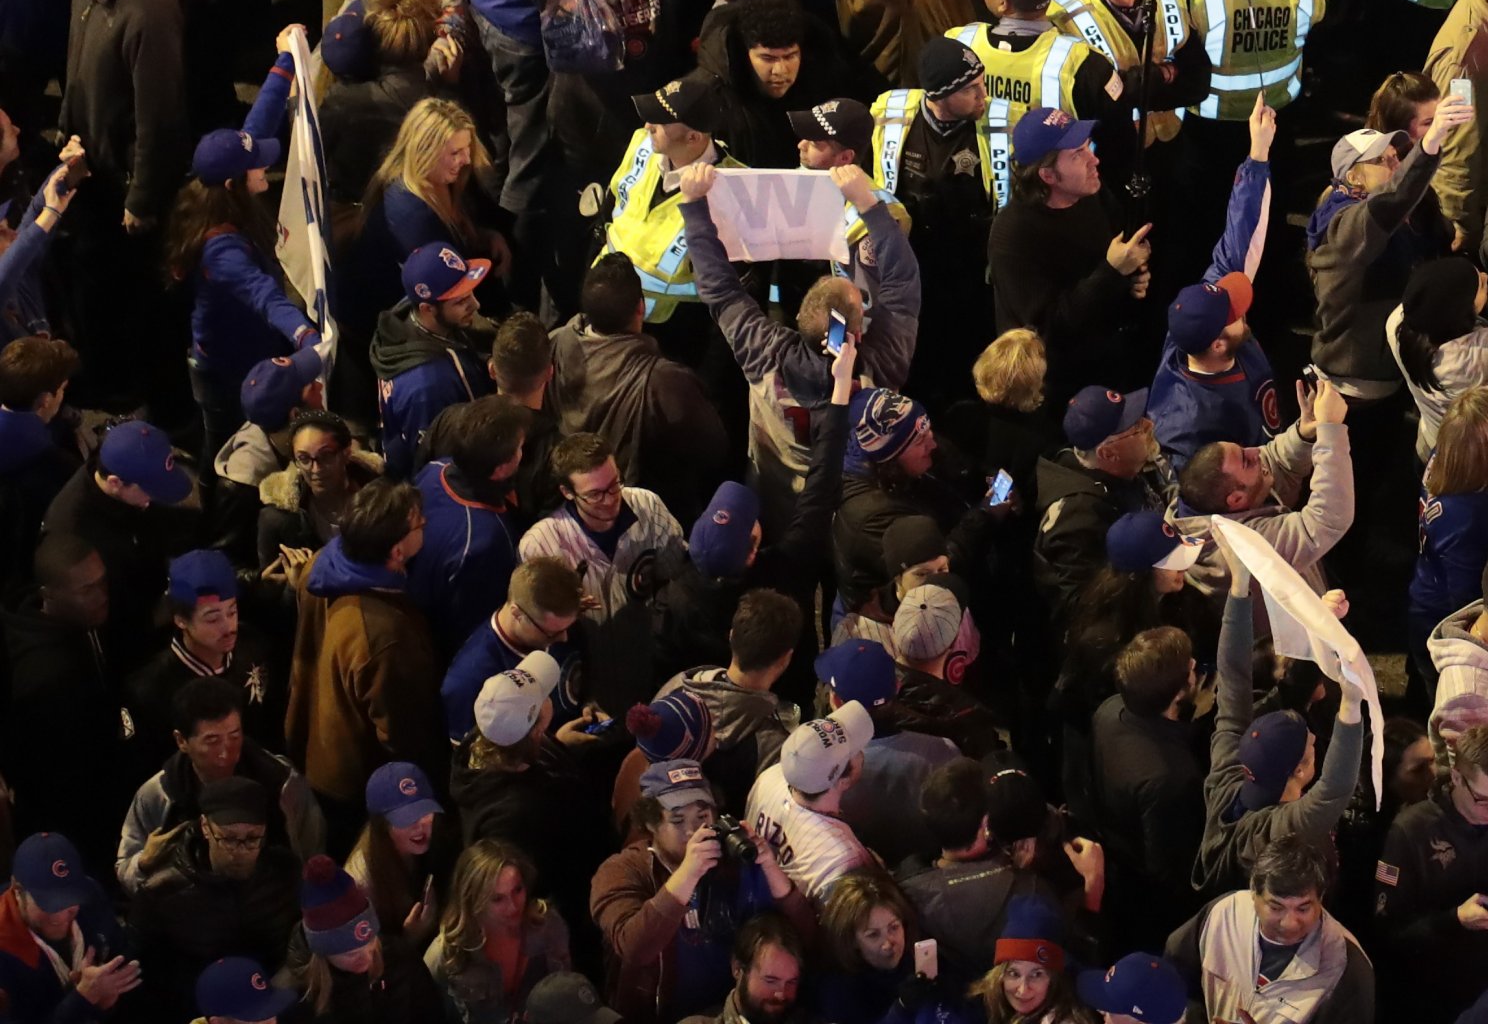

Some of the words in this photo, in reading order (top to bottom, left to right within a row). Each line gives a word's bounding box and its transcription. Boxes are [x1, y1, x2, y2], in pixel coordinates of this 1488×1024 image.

[1232, 29, 1289, 54] POLICE
[984, 74, 1032, 104] HICAGO
[723, 174, 817, 229] W
[53, 859, 70, 878] C
[354, 920, 373, 941] C
